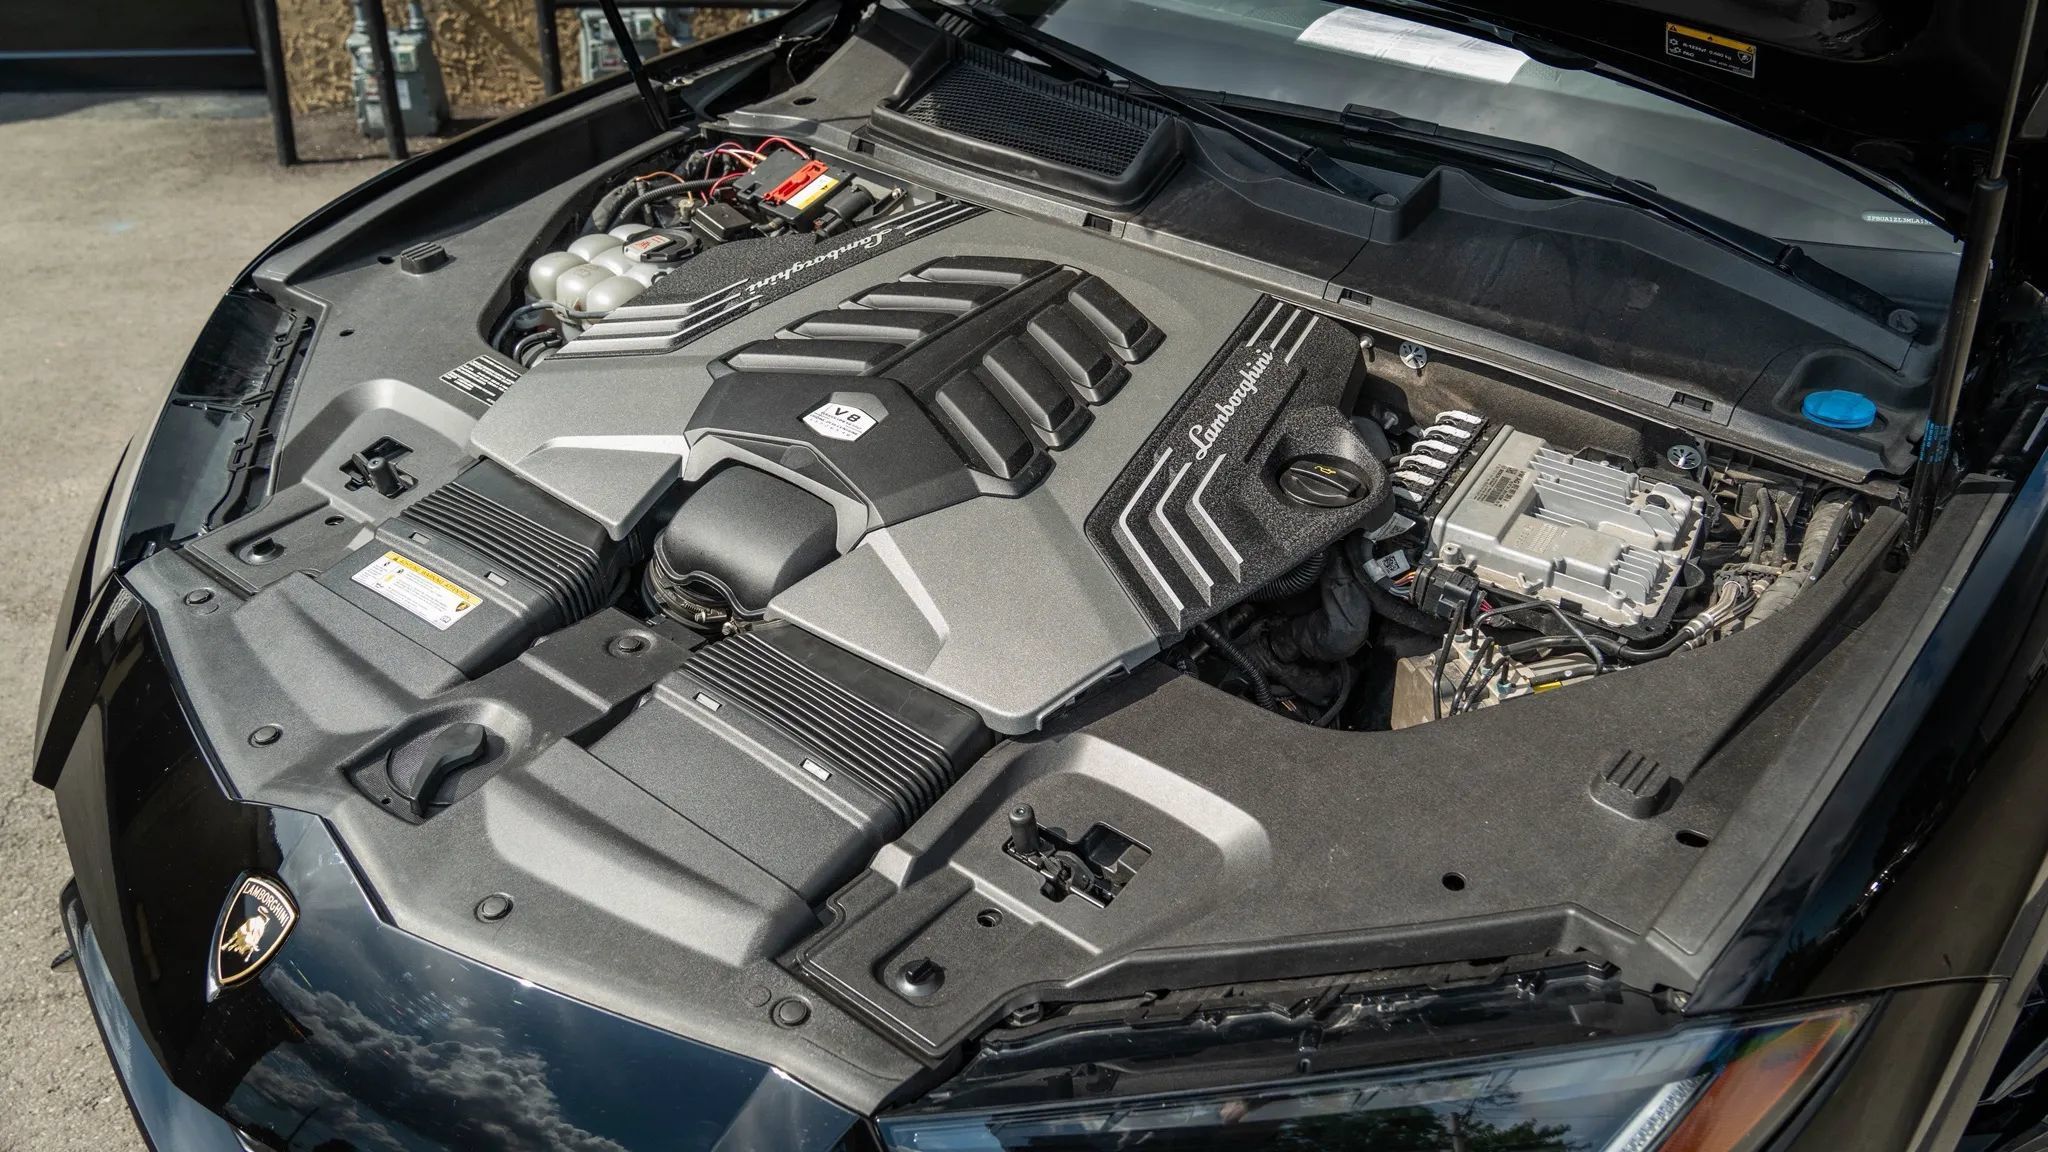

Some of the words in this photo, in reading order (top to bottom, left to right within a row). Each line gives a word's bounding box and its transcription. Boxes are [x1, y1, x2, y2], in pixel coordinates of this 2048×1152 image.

[745, 229, 893, 295] Lamborghini
[835, 407, 861, 422] V8
[1189, 349, 1273, 460] Lamborghini
[243, 882, 290, 928] LAMBORGHINI
